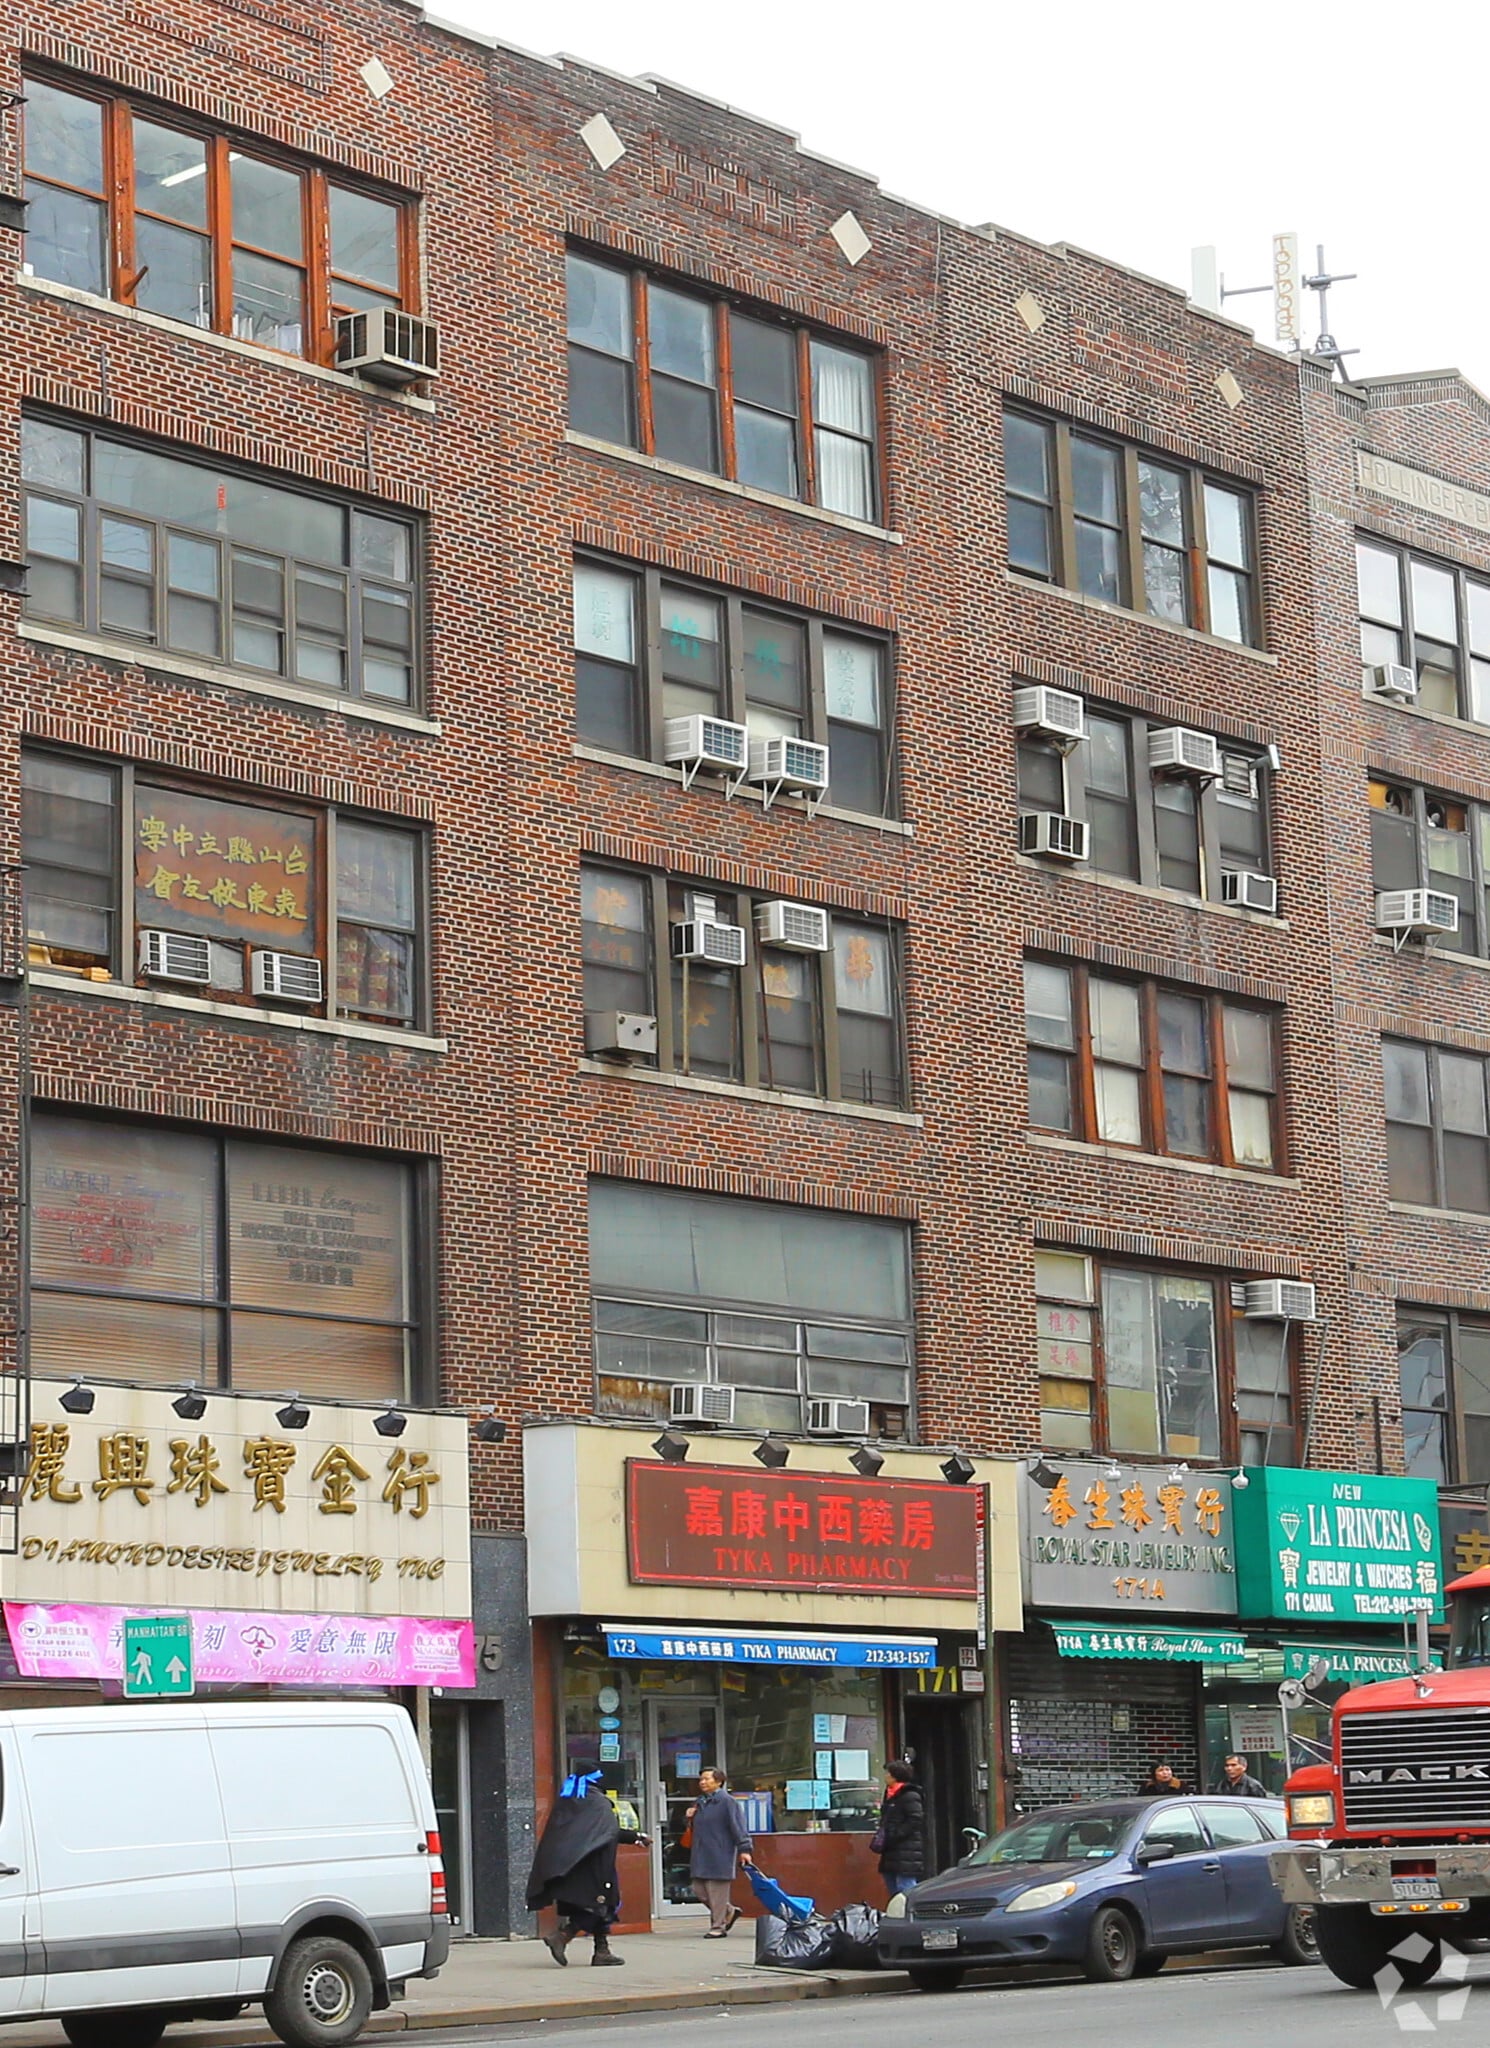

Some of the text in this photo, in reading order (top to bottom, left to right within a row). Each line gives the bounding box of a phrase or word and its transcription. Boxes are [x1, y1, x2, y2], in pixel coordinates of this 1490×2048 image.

[21, 1422, 442, 1518] 麗興珠寶金行
[1332, 1483, 1362, 1500] NEW
[684, 1485, 936, 1551] 嘉康中西藥房
[1307, 1504, 1411, 1551] LA PRINCESA
[713, 1547, 912, 1581] TYKA PHARMACY
[1033, 1535, 1088, 1566] ROYAL
[1091, 1538, 1130, 1568] STAR
[397, 1556, 446, 1580] INC
[1306, 1560, 1413, 1590] JEWELRY & WATCHES
[1415, 1561, 1438, 1595] 福
[1113, 1576, 1166, 1600] 171A
[1285, 1592, 1334, 1613] 171 CANAL
[613, 1639, 636, 1654] 173
[741, 1644, 772, 1659] TYKA
[777, 1645, 838, 1662] PHARMACY
[1056, 1635, 1083, 1649] 171A
[1151, 1637, 1187, 1657] Royal
[1219, 1642, 1245, 1656] 171A
[1333, 1655, 1350, 1671] LA
[1353, 1656, 1411, 1674] PRINCESA
[916, 1666, 958, 1693] 171
[1349, 1765, 1489, 1783] MACK
